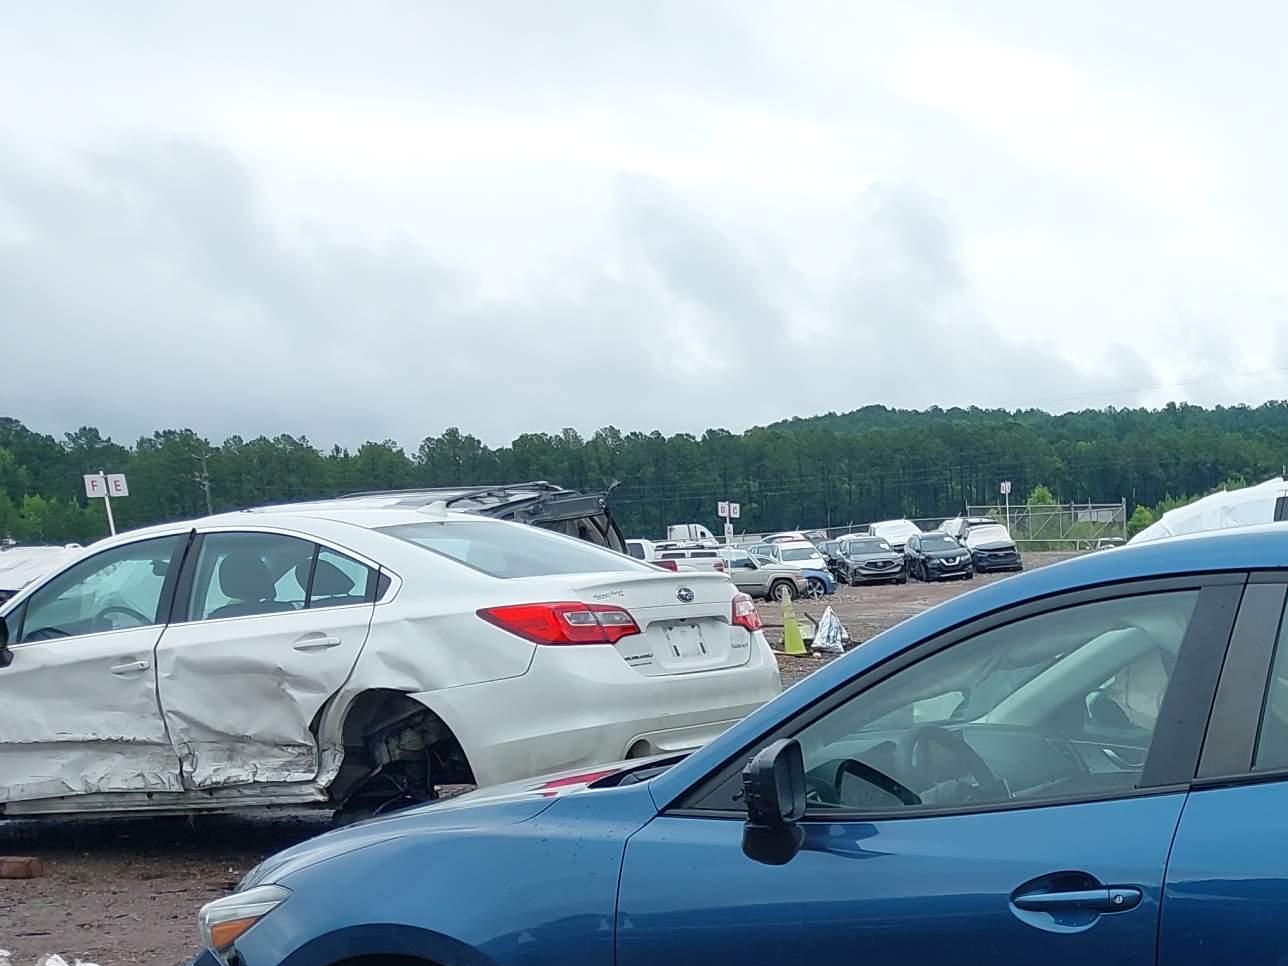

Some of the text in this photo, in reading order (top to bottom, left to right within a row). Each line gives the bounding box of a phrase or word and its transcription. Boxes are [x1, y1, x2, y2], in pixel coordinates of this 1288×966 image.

[90, 480, 98, 492] F
[114, 480, 122, 492] E
[720, 506, 726, 514] D
[732, 507, 738, 515] C
